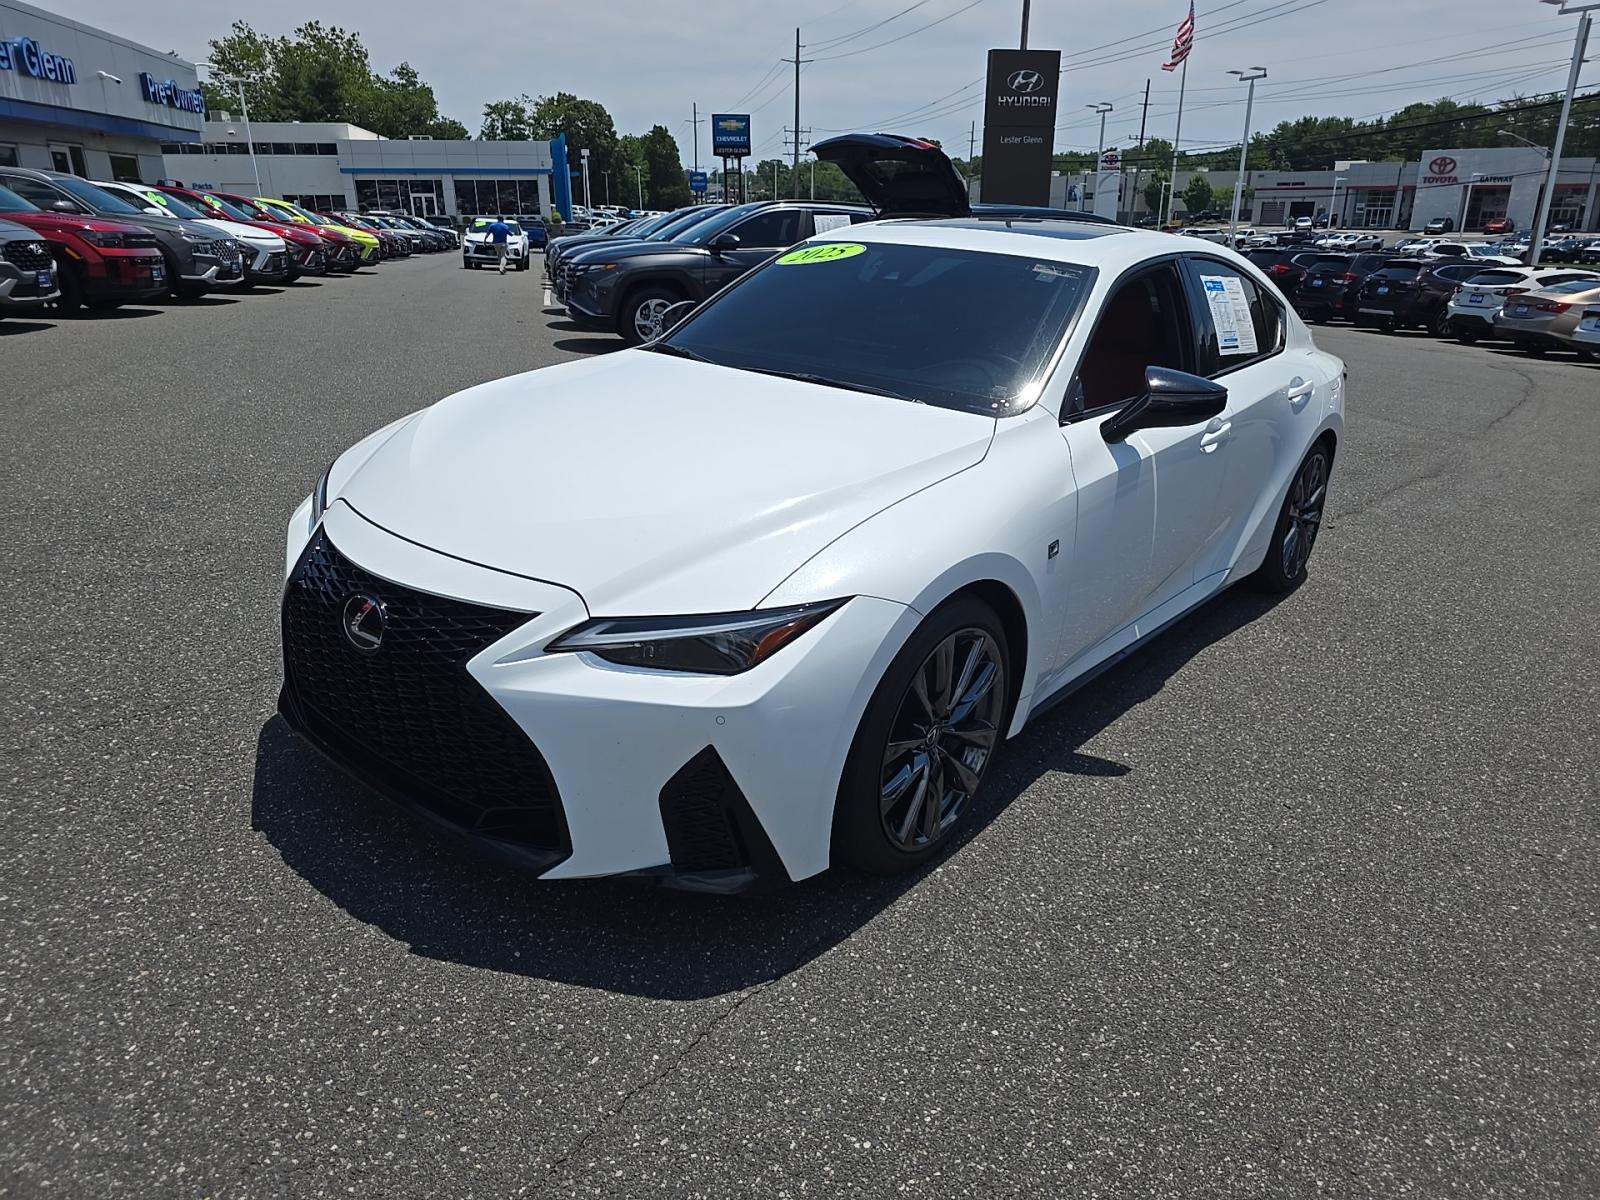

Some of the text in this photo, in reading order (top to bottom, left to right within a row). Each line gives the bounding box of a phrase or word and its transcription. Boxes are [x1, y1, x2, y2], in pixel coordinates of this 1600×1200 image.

[22, 37, 77, 83] Glenn
[145, 72, 206, 113] Pre-Owned
[998, 96, 1051, 106] HYUNDAI
[1000, 136, 1043, 144] Lester Glenn
[1422, 175, 1514, 184] TOYOTA GATEWAY
[785, 246, 855, 262] 2025
